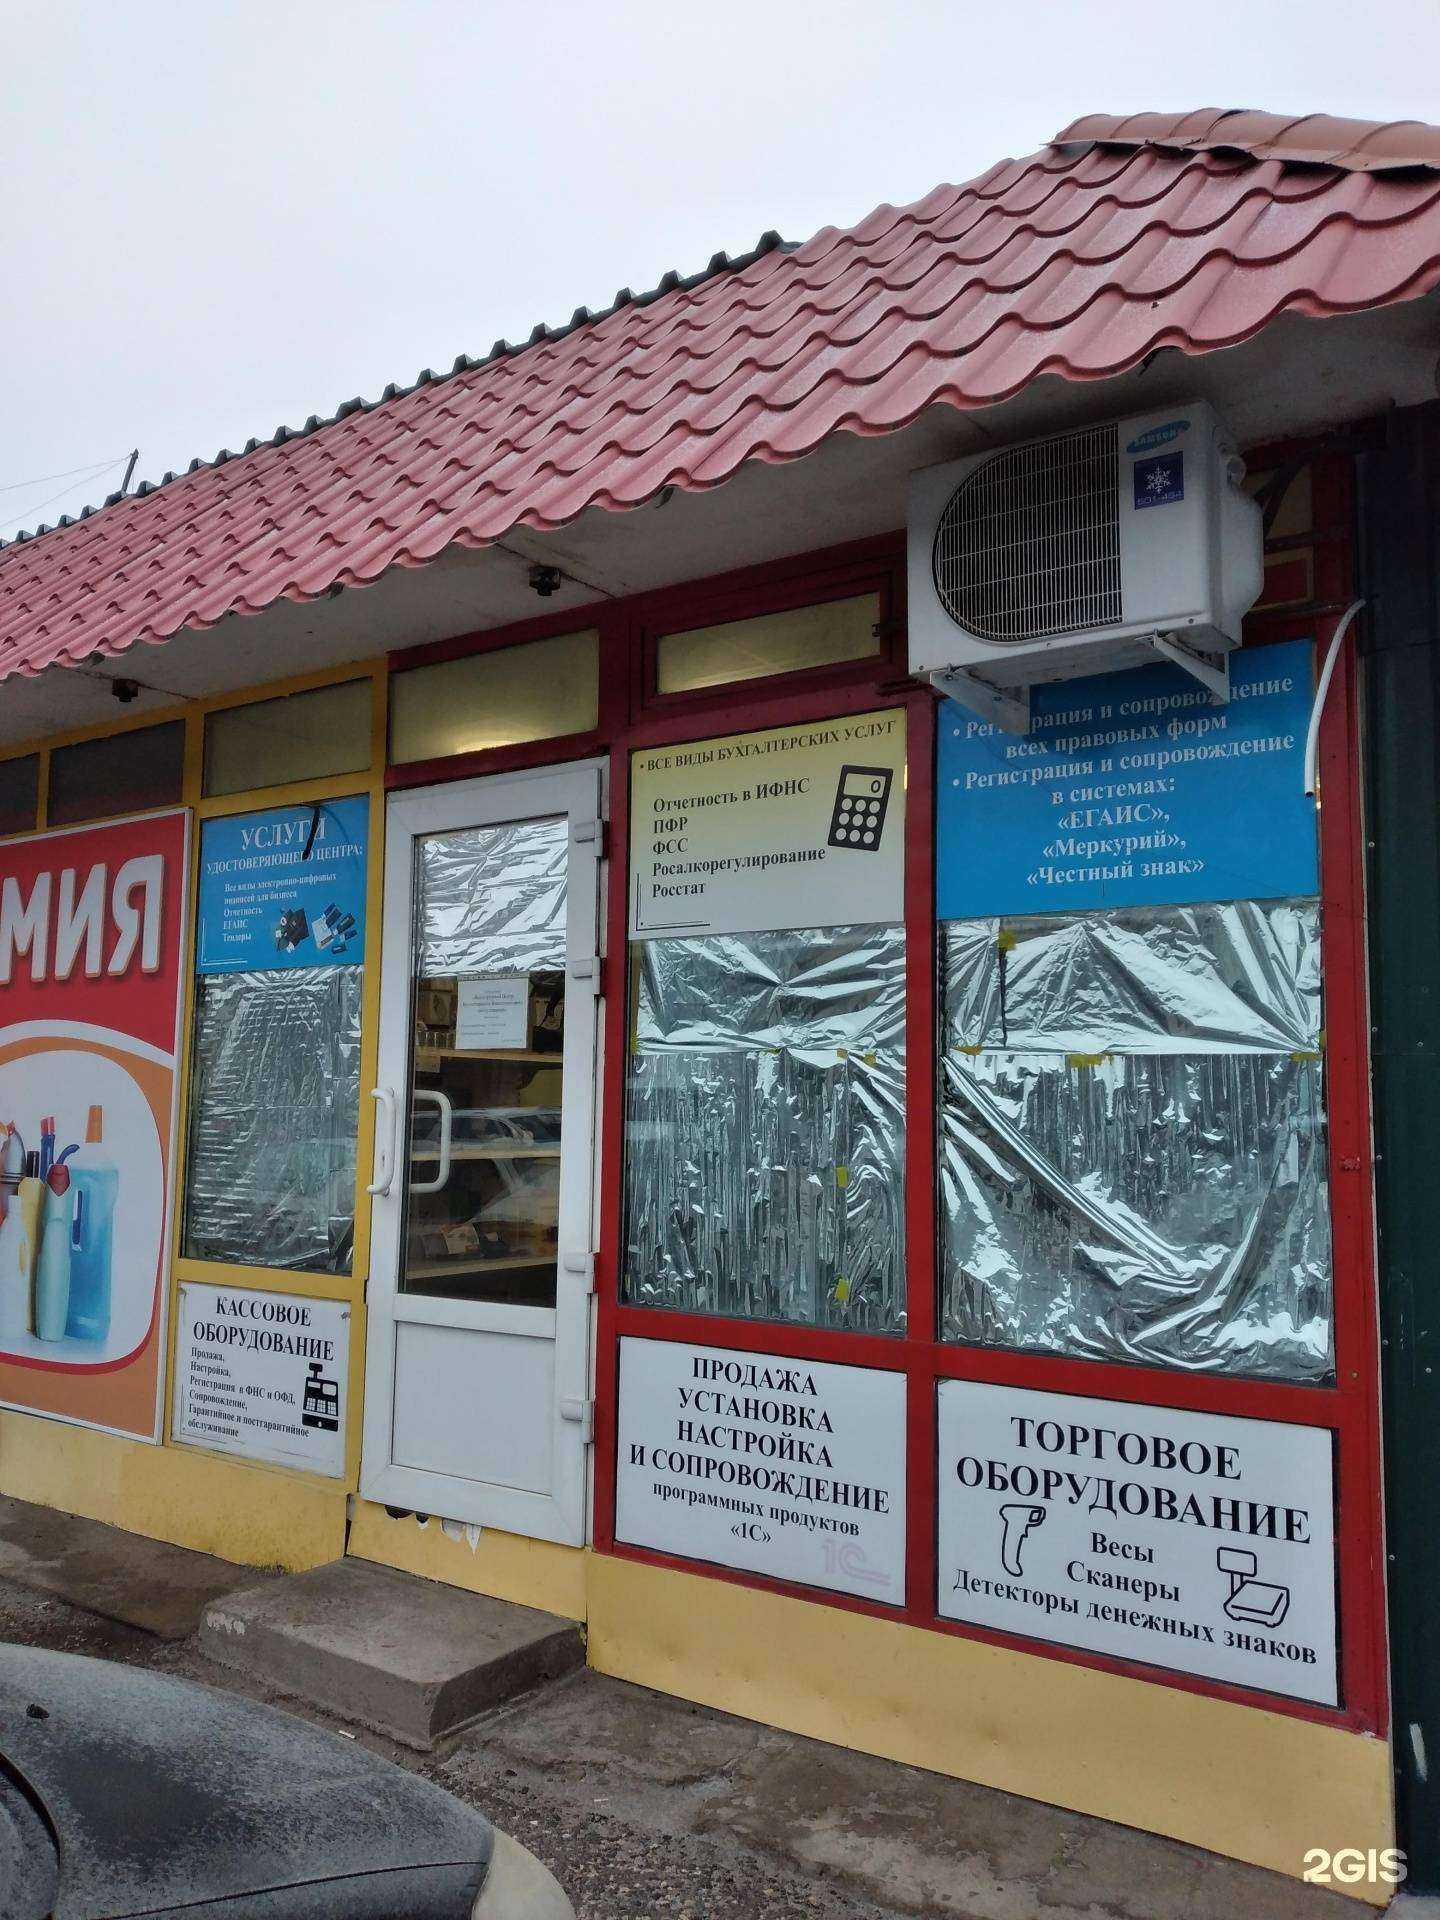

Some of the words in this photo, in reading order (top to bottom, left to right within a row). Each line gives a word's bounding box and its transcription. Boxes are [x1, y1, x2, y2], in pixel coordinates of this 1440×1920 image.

[966, 707, 1093, 740] Реграция
[1100, 703, 1112, 719] и
[1006, 741, 1048, 759] всех
[1055, 725, 1160, 755] правовых
[1167, 713, 1227, 744] форм
[647, 755, 672, 771] ВСЕ
[675, 749, 715, 767] ВИДЫ
[717, 730, 841, 762] БУХГАЛТЕРСКИХ
[844, 720, 897, 742] УСЛУГ
[965, 759, 1093, 790] Регистрация
[1100, 757, 1113, 773] и
[1119, 734, 1295, 770] сопровождение
[653, 789, 738, 813] Отчетность
[743, 788, 751, 800] в
[756, 777, 810, 800] ИФНС
[1051, 790, 1063, 805] в
[1070, 777, 1176, 803] системах:
[653, 816, 688, 834] ПФР
[1058, 803, 1170, 830] «ЕГАИС»,
[317, 844, 363, 861] ЦЕНТРА:
[652, 838, 689, 855] ФСС
[1042, 830, 1187, 859] «Меркурий»,
[651, 848, 826, 877] Росалкорегулирование
[1027, 860, 1133, 887] «Честный
[1140, 857, 1205, 877] знак»
[652, 882, 706, 898] Росстат
[0, 854, 164, 985] МИЯ
[223, 919, 248, 930] ЕГАИС
[216, 1295, 312, 1327] КАССОВОЕ
[191, 1347, 225, 1362] Продажа,
[193, 1321, 334, 1361] ОБОРУДОВАНИЕ
[190, 1361, 231, 1378] Настройка,
[692, 1357, 818, 1396] ПРОДАЖА
[189, 1389, 248, 1412] Сопровождение,
[190, 1375, 235, 1392] Регистрация
[245, 1385, 266, 1398] ФНС
[189, 1404, 234, 1421] Гарантийное
[243, 1416, 309, 1437] постгарантийное
[678, 1387, 834, 1433] УСТАНОВКА
[188, 1419, 239, 1437] обслуживание
[676, 1419, 834, 1468] НАСТРОЙКА
[1010, 1416, 1242, 1480] ТОРГОВОЕ
[629, 1444, 646, 1466] И
[652, 1448, 890, 1514] СОПРОВОЖДЕНИЕ
[653, 1482, 764, 1517] программных
[769, 1506, 860, 1536] продуктов
[956, 1456, 1312, 1544] ОБОРУДОВАНИЕ
[730, 1523, 772, 1544] «1С»
[1090, 1531, 1154, 1563] Весы
[1066, 1561, 1180, 1601] Сканеры
[953, 1568, 1079, 1614] Детекторы
[1086, 1601, 1215, 1643] денежных
[1223, 1628, 1317, 1664] знаков
